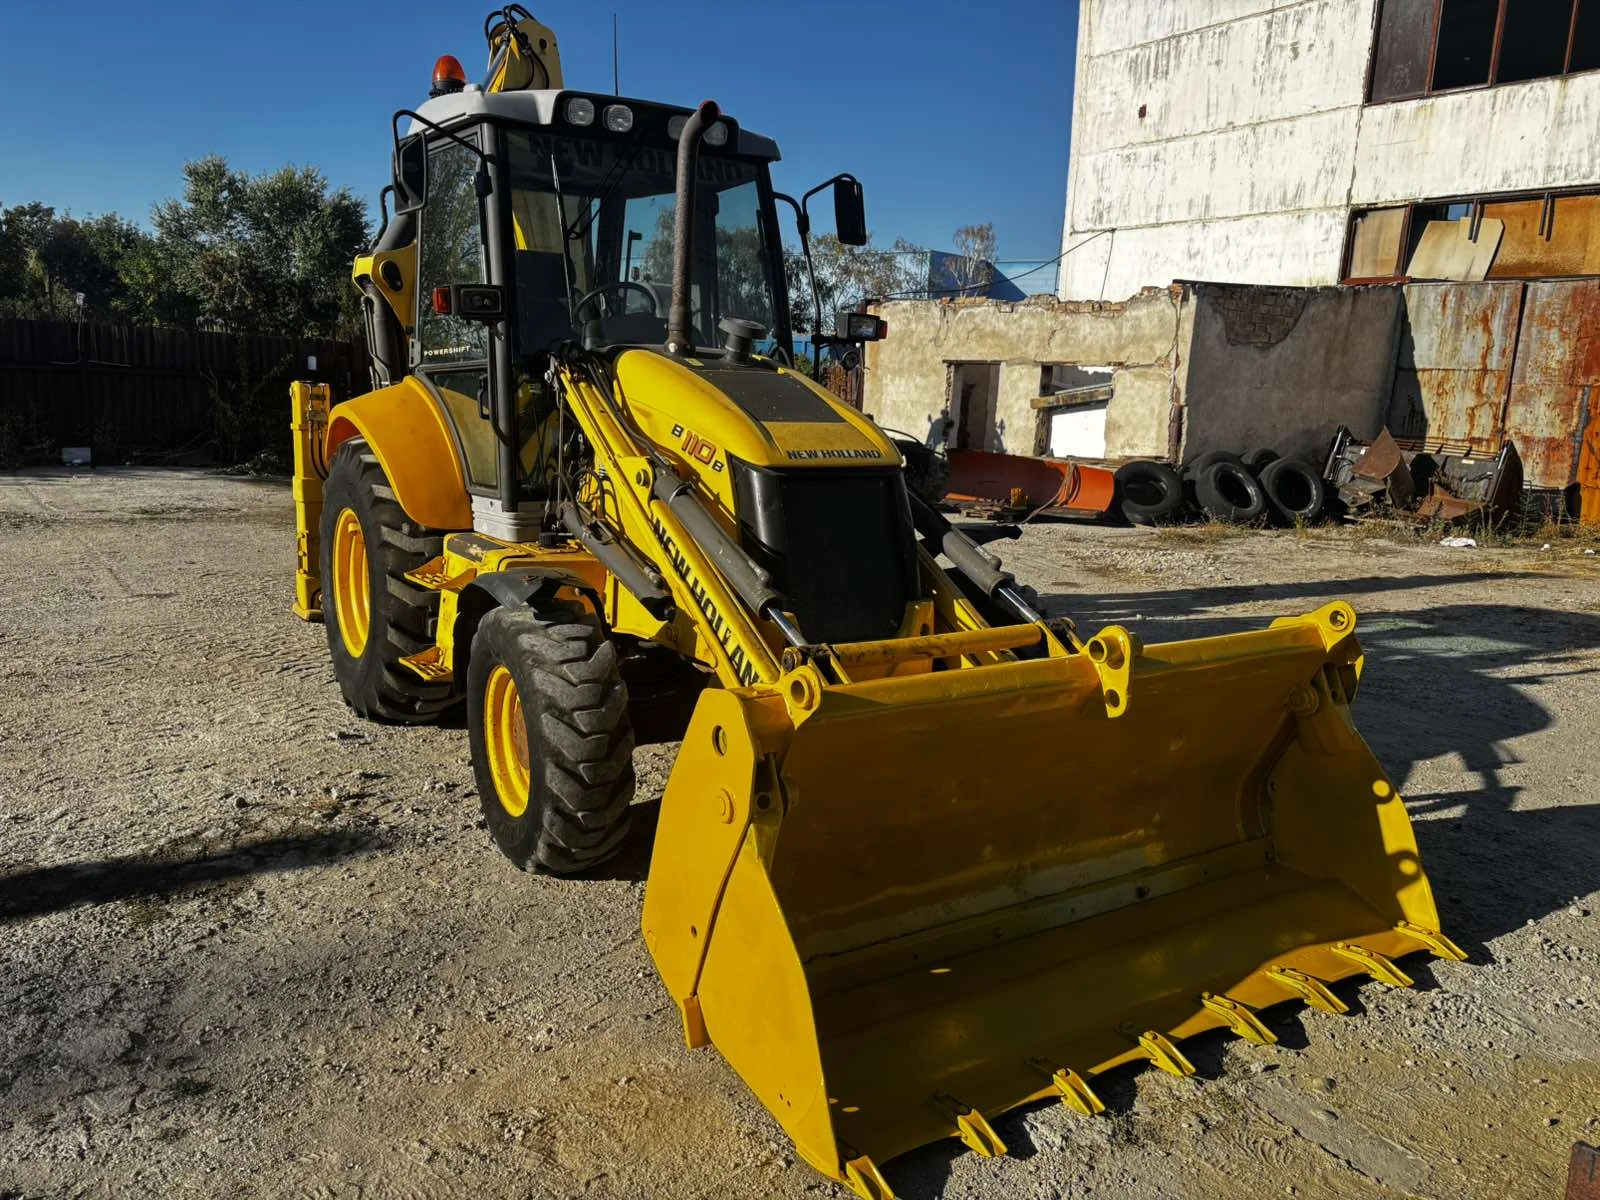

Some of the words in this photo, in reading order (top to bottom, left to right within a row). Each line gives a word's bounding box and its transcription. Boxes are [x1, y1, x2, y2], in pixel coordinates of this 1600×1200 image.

[424, 346, 471, 357] POWERSHIFT
[787, 449, 819, 460] NEW
[821, 449, 880, 459] HOLLAND
[652, 517, 692, 583] NEW
[690, 577, 761, 687] HOLLAN
